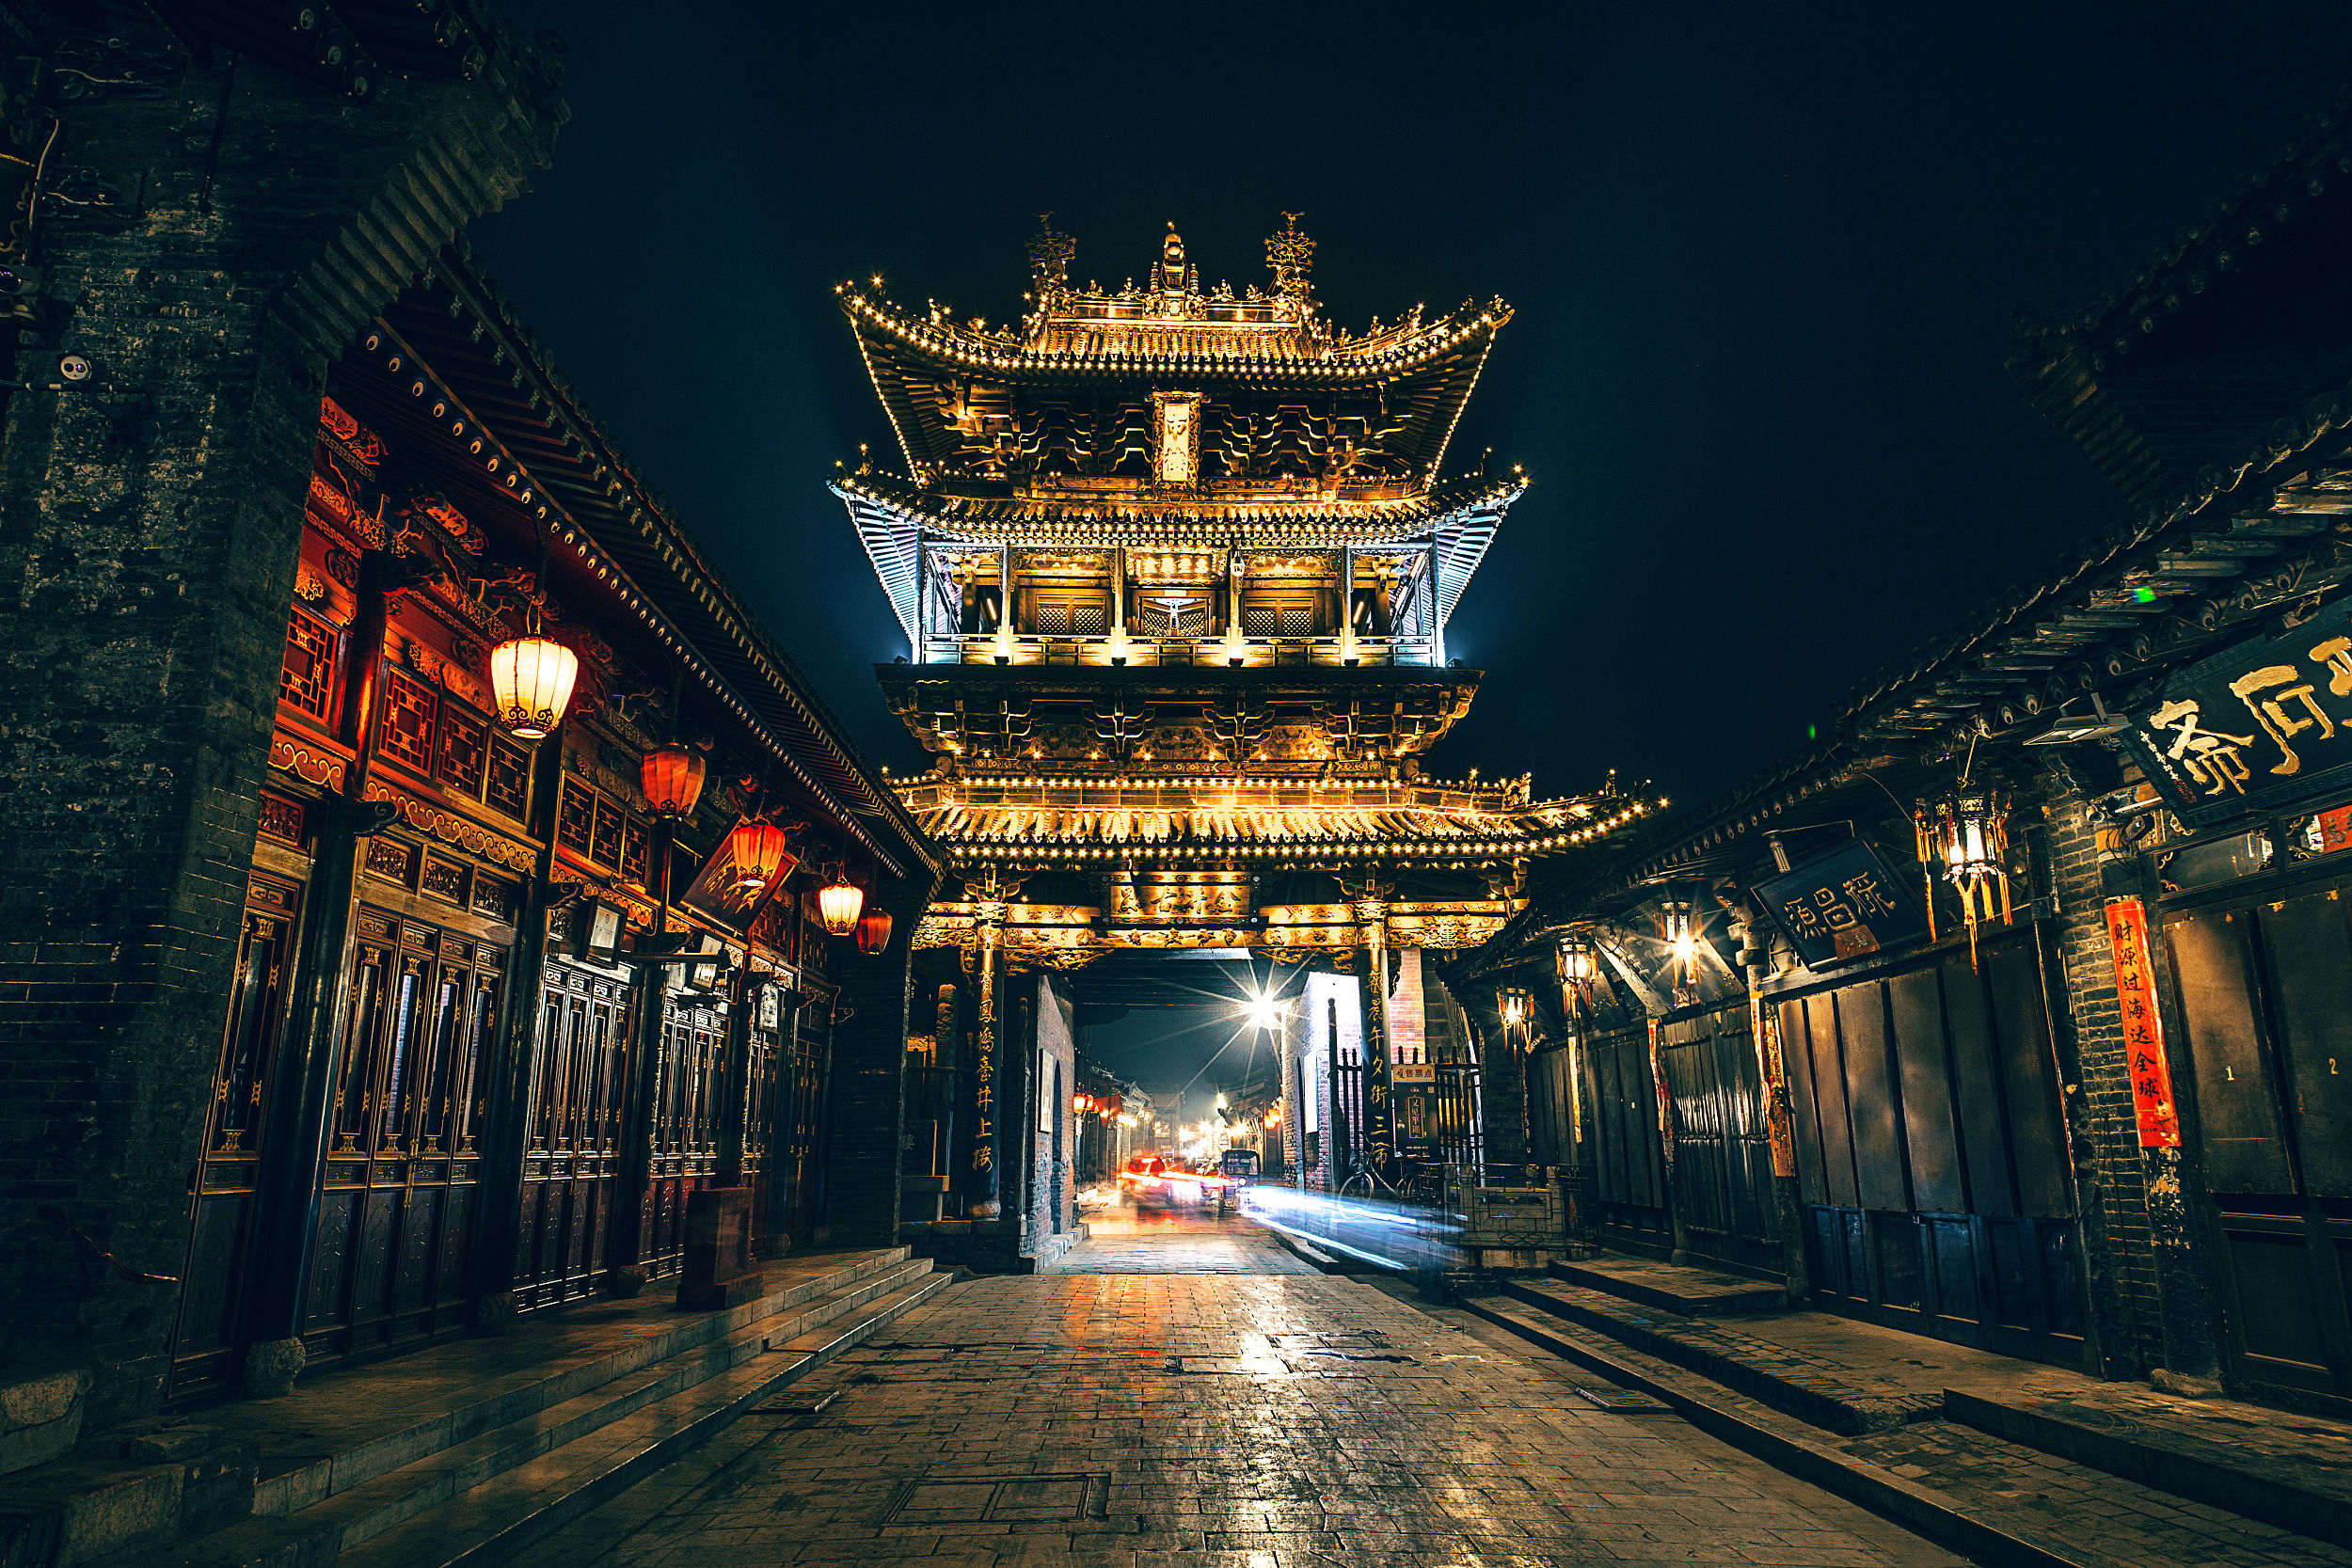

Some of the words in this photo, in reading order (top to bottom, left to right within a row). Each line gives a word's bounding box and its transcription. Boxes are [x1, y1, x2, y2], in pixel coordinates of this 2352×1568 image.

[2115, 922, 2159, 1098] 财源过海达全球
[1406, 1069, 1433, 1078] 售票点
[2225, 1065, 2235, 1081] 1
[2328, 1057, 2339, 1075] 2
